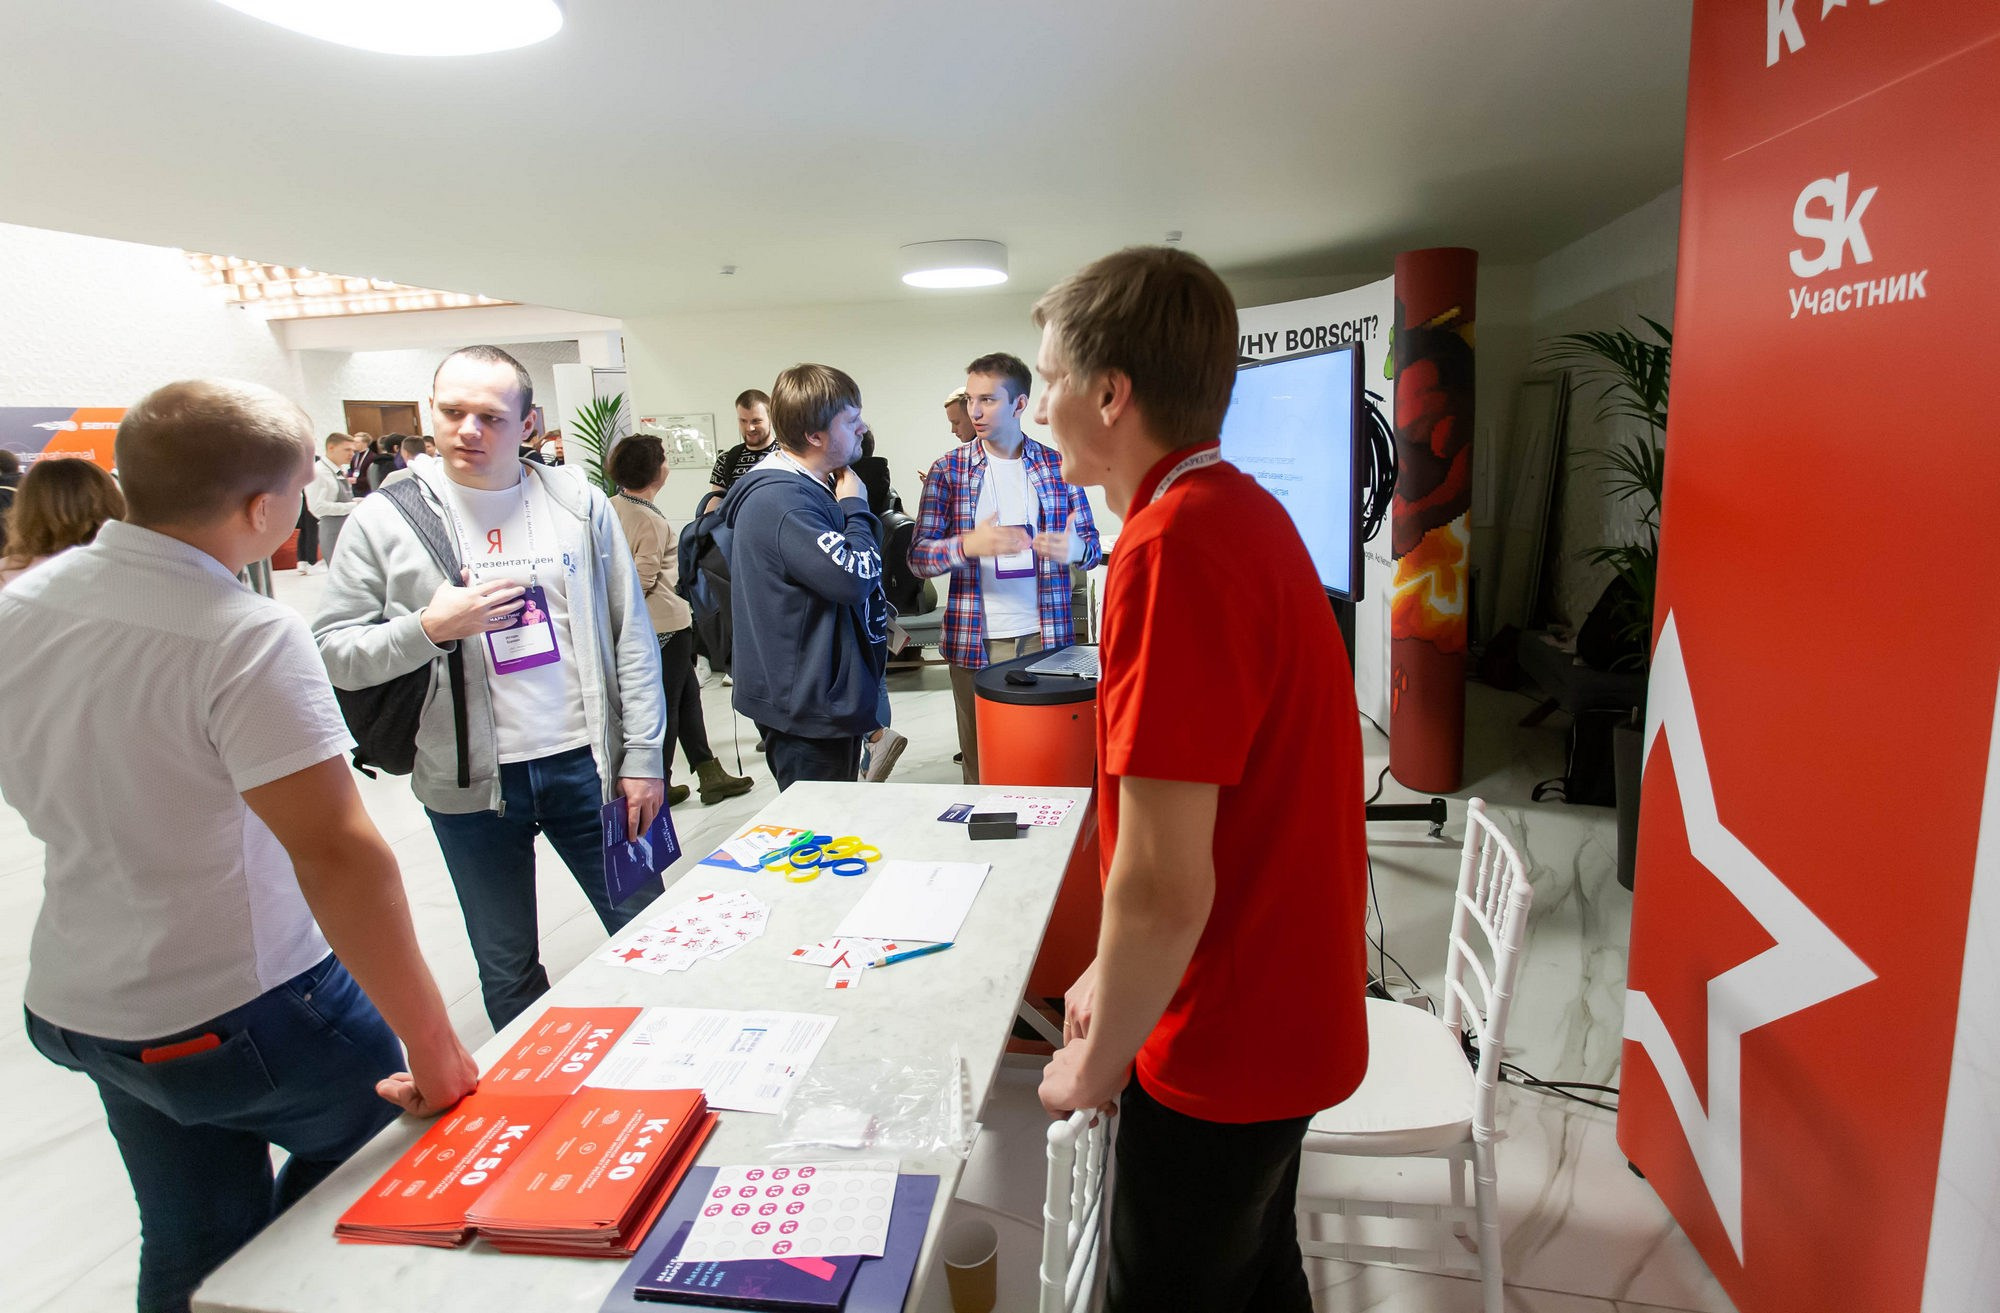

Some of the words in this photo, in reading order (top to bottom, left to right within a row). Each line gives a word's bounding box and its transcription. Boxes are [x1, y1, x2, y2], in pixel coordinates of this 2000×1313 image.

[1789, 171, 1879, 278] Sk
[1788, 269, 1928, 319] Участник
[1285, 314, 1379, 352] BORSCHT?
[15, 448, 96, 462] nternational
[486, 528, 503, 554] Я
[750, 1170, 762, 1180] 21
[776, 1169, 787, 1179] 21
[801, 1168, 813, 1177] 21
[716, 1186, 728, 1197] 21
[743, 1187, 755, 1197] 21
[769, 1186, 781, 1196] 21
[795, 1185, 807, 1195] 21
[708, 1205, 720, 1216] 21
[735, 1205, 748, 1215] 21
[762, 1204, 775, 1215] 21
[789, 1203, 802, 1213] 21
[755, 1223, 768, 1233] 21
[783, 1222, 796, 1232] 21
[776, 1241, 789, 1253] 21
[710, 1271, 726, 1288] walk
